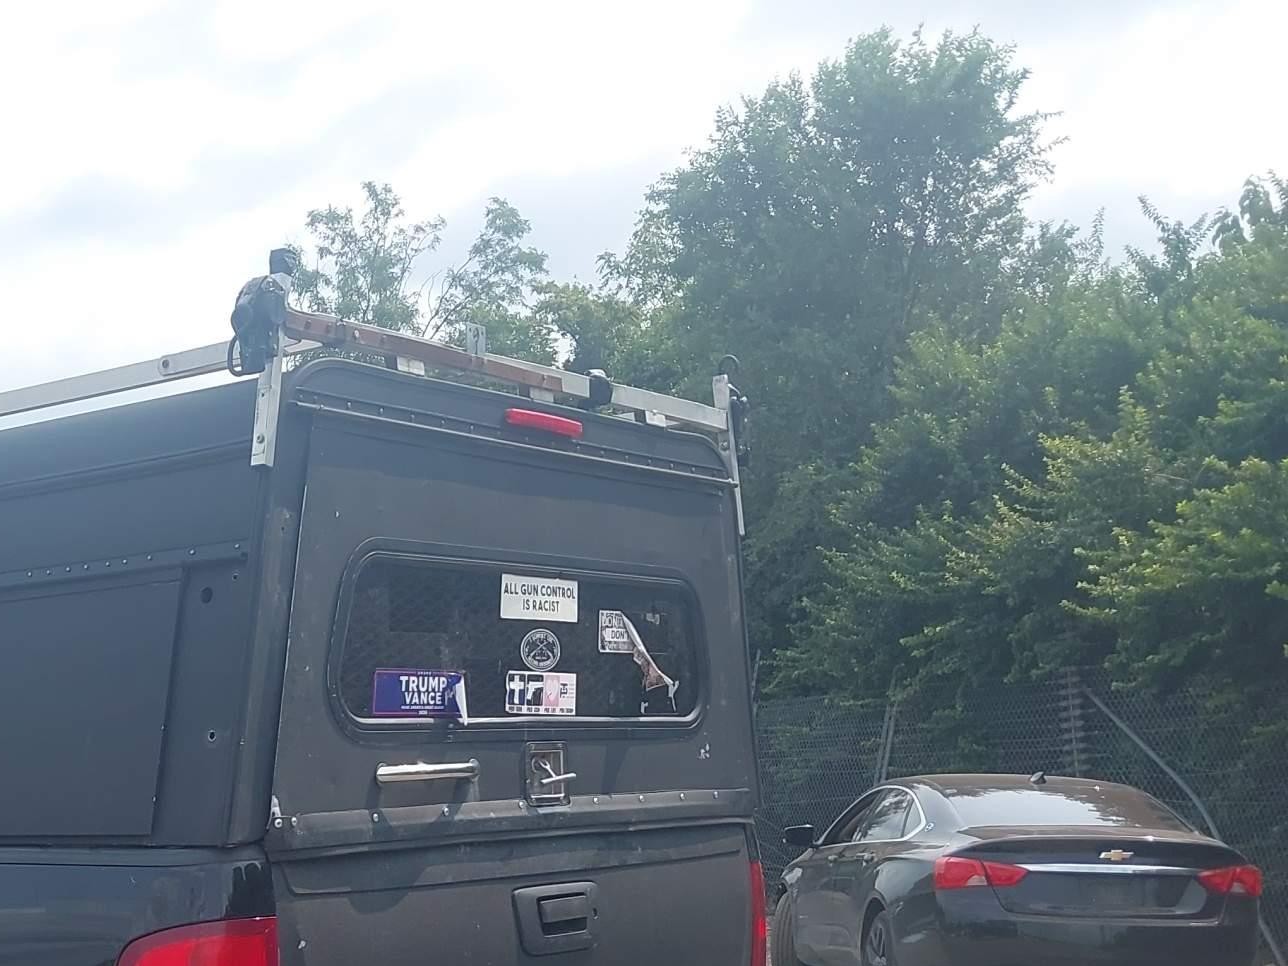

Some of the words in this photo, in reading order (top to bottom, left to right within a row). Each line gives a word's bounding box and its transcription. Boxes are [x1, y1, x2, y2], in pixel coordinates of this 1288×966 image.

[503, 582, 519, 595] ALL
[520, 583, 539, 597] GUN
[540, 584, 576, 600] CONTROL
[522, 598, 531, 611] IS
[532, 599, 560, 613] RACIST
[399, 675, 448, 692] TRUMP
[404, 691, 443, 705] VANCE
